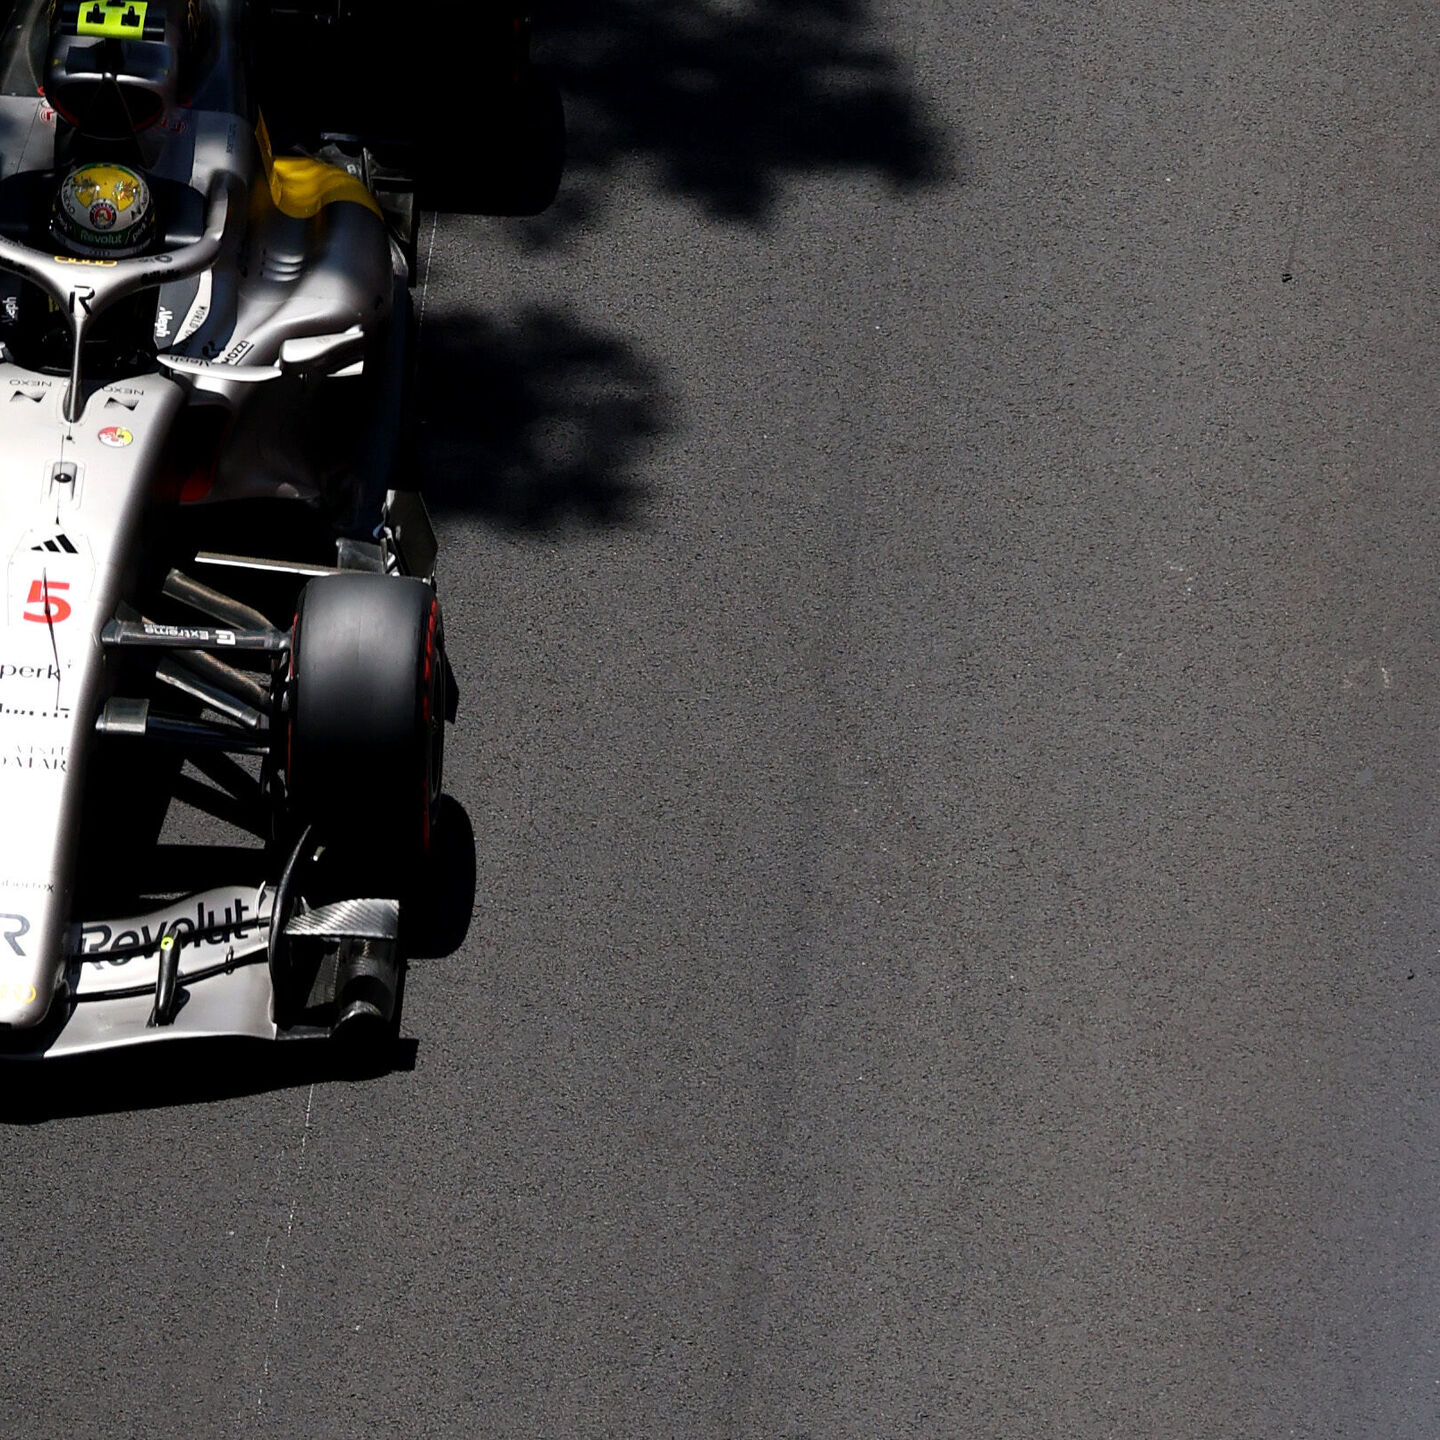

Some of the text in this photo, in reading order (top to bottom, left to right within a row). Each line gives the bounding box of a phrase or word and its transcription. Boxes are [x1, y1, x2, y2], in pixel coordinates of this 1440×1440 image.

[80, 229, 122, 244] Revolut
[69, 284, 95, 316] R
[221, 340, 250, 364] MOZZI
[9, 379, 52, 387] NEXO
[102, 385, 145, 396] NEXO
[23, 580, 72, 623] 5
[144, 625, 209, 640] Extreme
[0, 664, 61, 680] perk
[82, 898, 250, 970] Revolut
